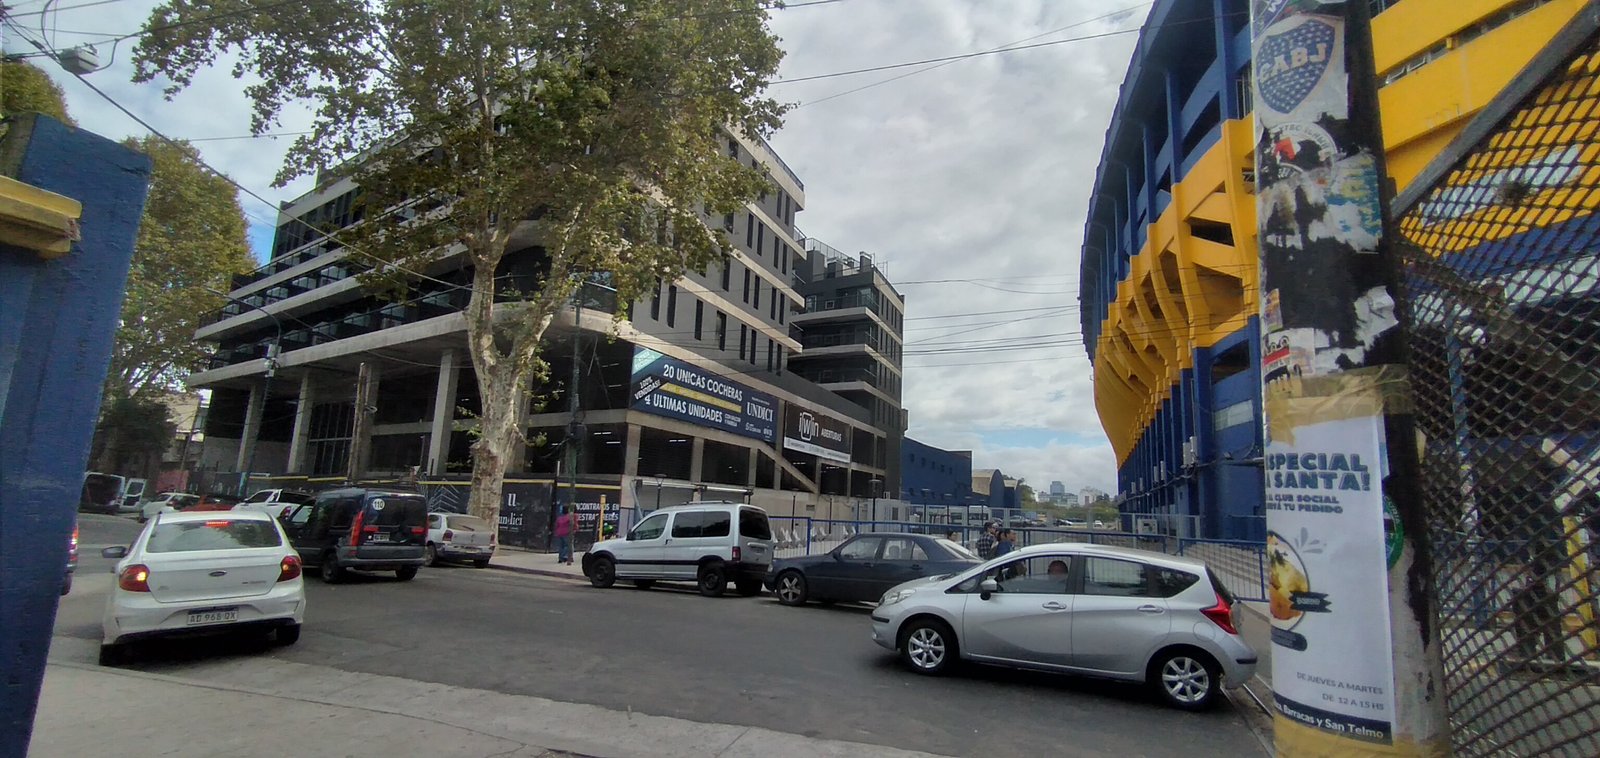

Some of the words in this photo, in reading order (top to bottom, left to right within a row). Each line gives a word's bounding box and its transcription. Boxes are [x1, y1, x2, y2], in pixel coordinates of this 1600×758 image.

[1259, 43, 1328, 83] CABJ
[663, 364, 675, 378] 20
[676, 367, 706, 389] UNICAS
[706, 381, 743, 402] COCHERAS
[653, 394, 687, 414] ULTIMAS
[688, 403, 723, 423] UNIDADES
[746, 402, 774, 422] UNDICI
[1274, 471, 1371, 491] SANTA!
[374, 500, 384, 509] 110
[574, 502, 610, 511] NCONTRAOS
[1296, 495, 1340, 504] SOCIAL
[1297, 504, 1344, 514] PEDIDO
[1296, 671, 1306, 679] DE
[1307, 674, 1337, 688] JUEVES
[1346, 683, 1384, 695] MARTES
[1322, 693, 1334, 702] DE
[1338, 696, 1349, 705] 12
[1350, 699, 1358, 707] A
[1360, 701, 1370, 710] 15
[1371, 702, 1385, 711] HS
[1283, 704, 1315, 724] Barracas
[1316, 717, 1323, 728] y
[1325, 719, 1345, 732] San
[1347, 723, 1385, 740] Telmo
